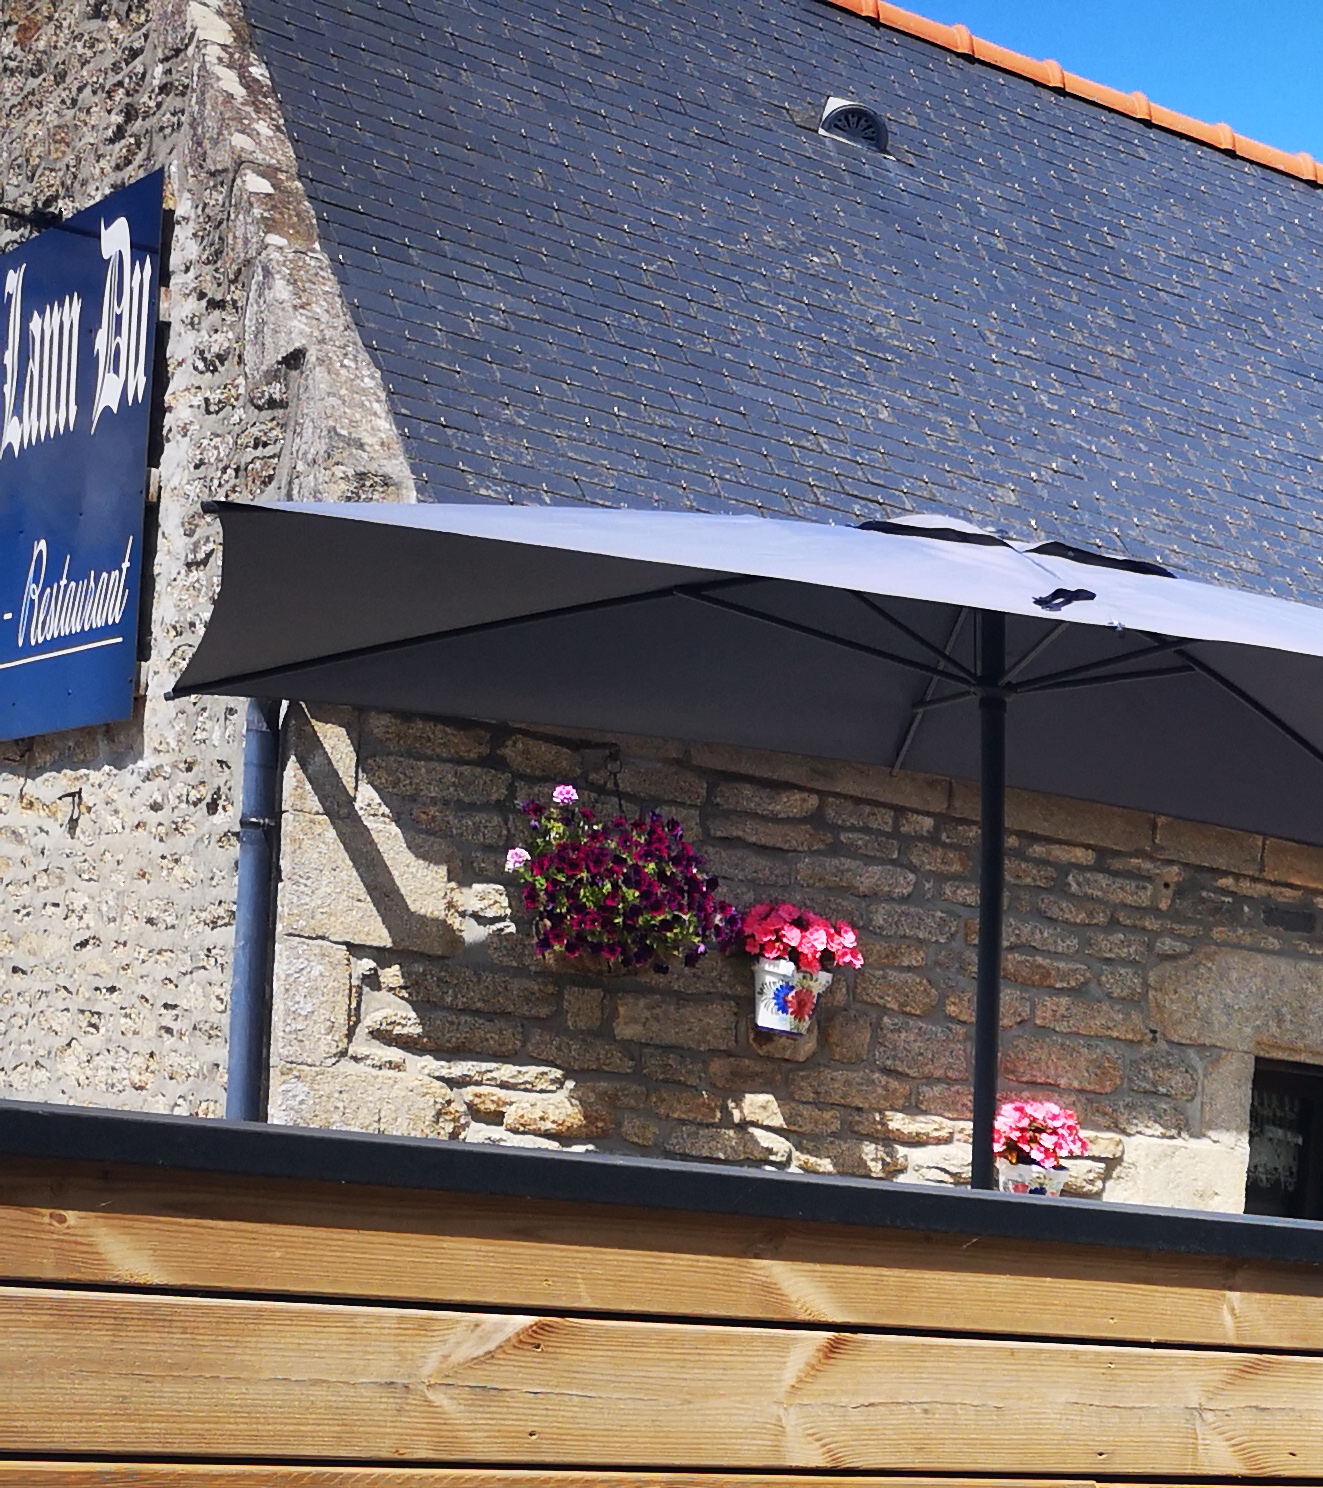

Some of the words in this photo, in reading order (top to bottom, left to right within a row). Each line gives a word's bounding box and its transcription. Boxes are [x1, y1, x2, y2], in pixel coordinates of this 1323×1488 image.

[0, 262, 82, 460] Lann
[91, 216, 152, 436] Du
[18, 535, 133, 648] Restaurant
